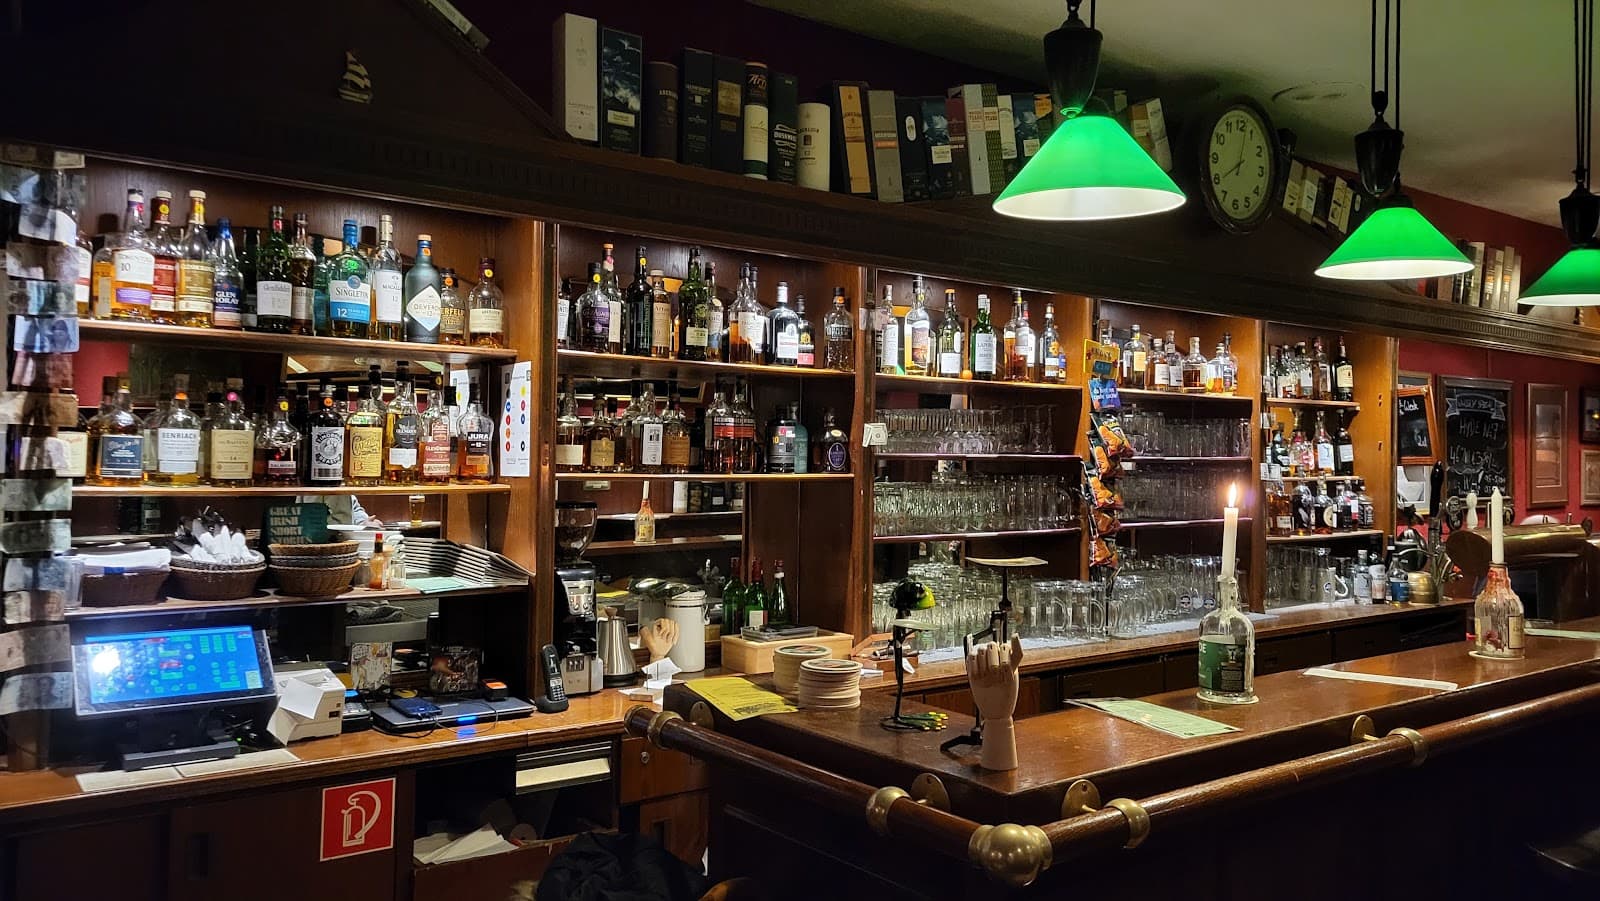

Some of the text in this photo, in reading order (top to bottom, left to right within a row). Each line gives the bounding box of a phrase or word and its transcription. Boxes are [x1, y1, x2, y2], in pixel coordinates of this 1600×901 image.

[1226, 121, 1232, 133] 11
[1236, 120, 1246, 132] 12
[1215, 133, 1225, 145] 10
[1250, 130, 1254, 141] 1
[1256, 146, 1263, 157] 2
[1211, 152, 1218, 164] 9
[1257, 166, 1264, 177] 3
[1213, 173, 1220, 185] 8
[1221, 190, 1228, 202] 7
[1253, 185, 1260, 196] 4
[1232, 199, 1239, 210] 6
[1243, 196, 1250, 208] 5
[121, 263, 131, 271] 10
[337, 308, 348, 317] 12
[270, 506, 302, 515] GREAT
[270, 516, 298, 526] IRISH
[270, 526, 302, 535] SHORT
[271, 536, 312, 544] STORIES
